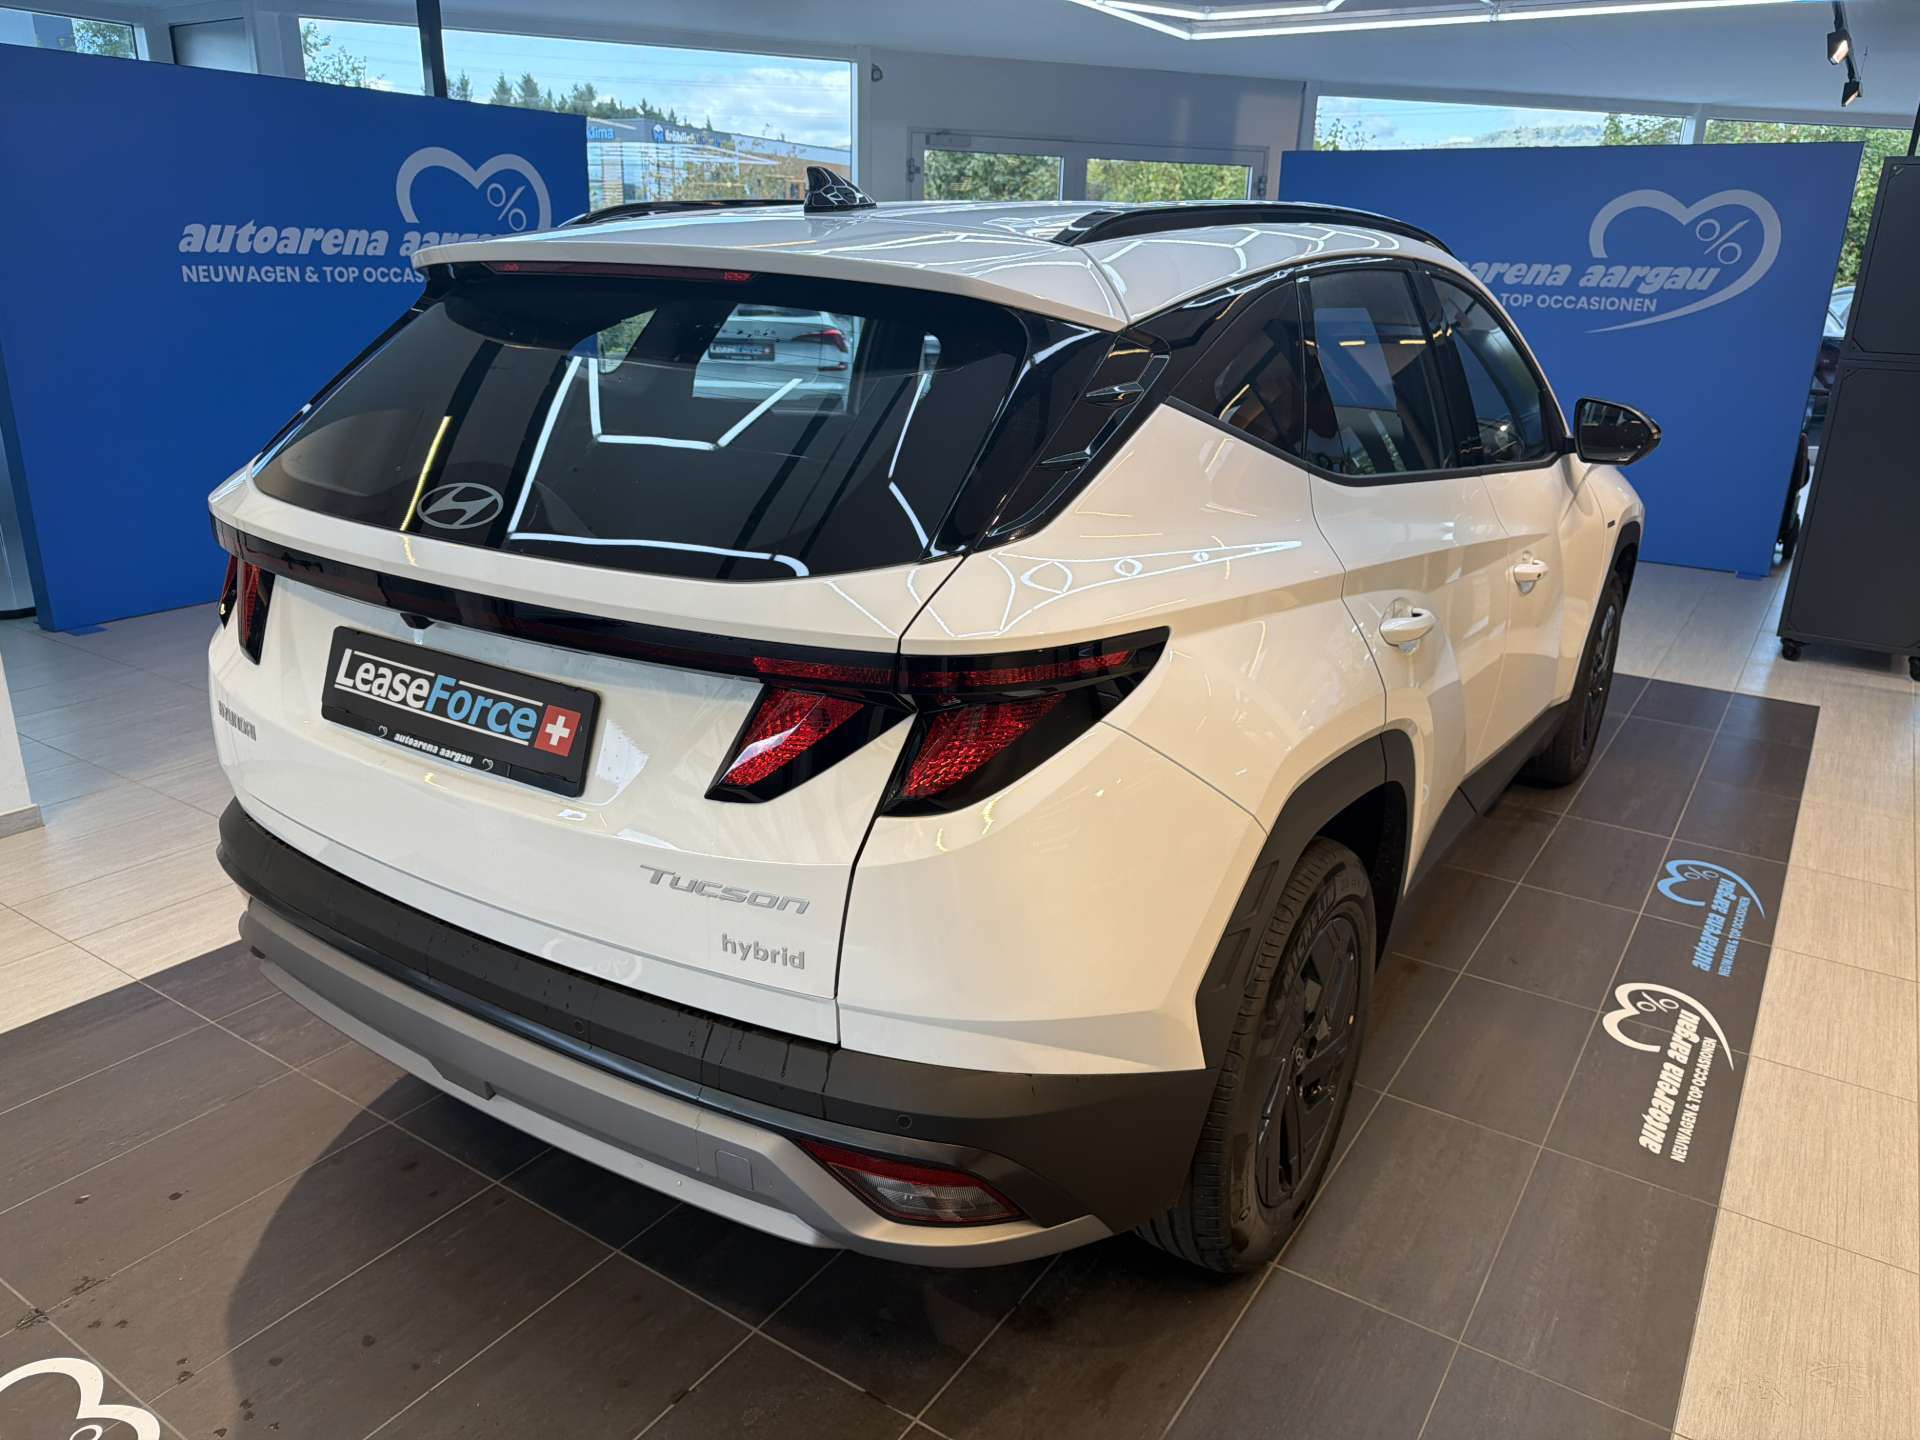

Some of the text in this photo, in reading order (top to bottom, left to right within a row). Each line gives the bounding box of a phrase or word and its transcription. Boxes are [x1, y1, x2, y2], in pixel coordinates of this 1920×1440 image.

[178, 219, 389, 256] autoarena
[182, 265, 300, 283] NEUWAGEN
[305, 267, 320, 283] &
[323, 267, 359, 282] TOP
[1579, 264, 1721, 294] aargau
[1500, 293, 1657, 312] TOP OCCASIONEN
[334, 648, 538, 740] LeaseForce
[394, 733, 474, 765] autoarena aargau
[1691, 878, 1737, 972] autoarena aargau
[721, 933, 805, 970] hybrid
[1638, 1009, 1701, 1155] autoarena aargau
[1670, 1036, 1718, 1163] NEUWAGEN & TOP OCCASIONEN
